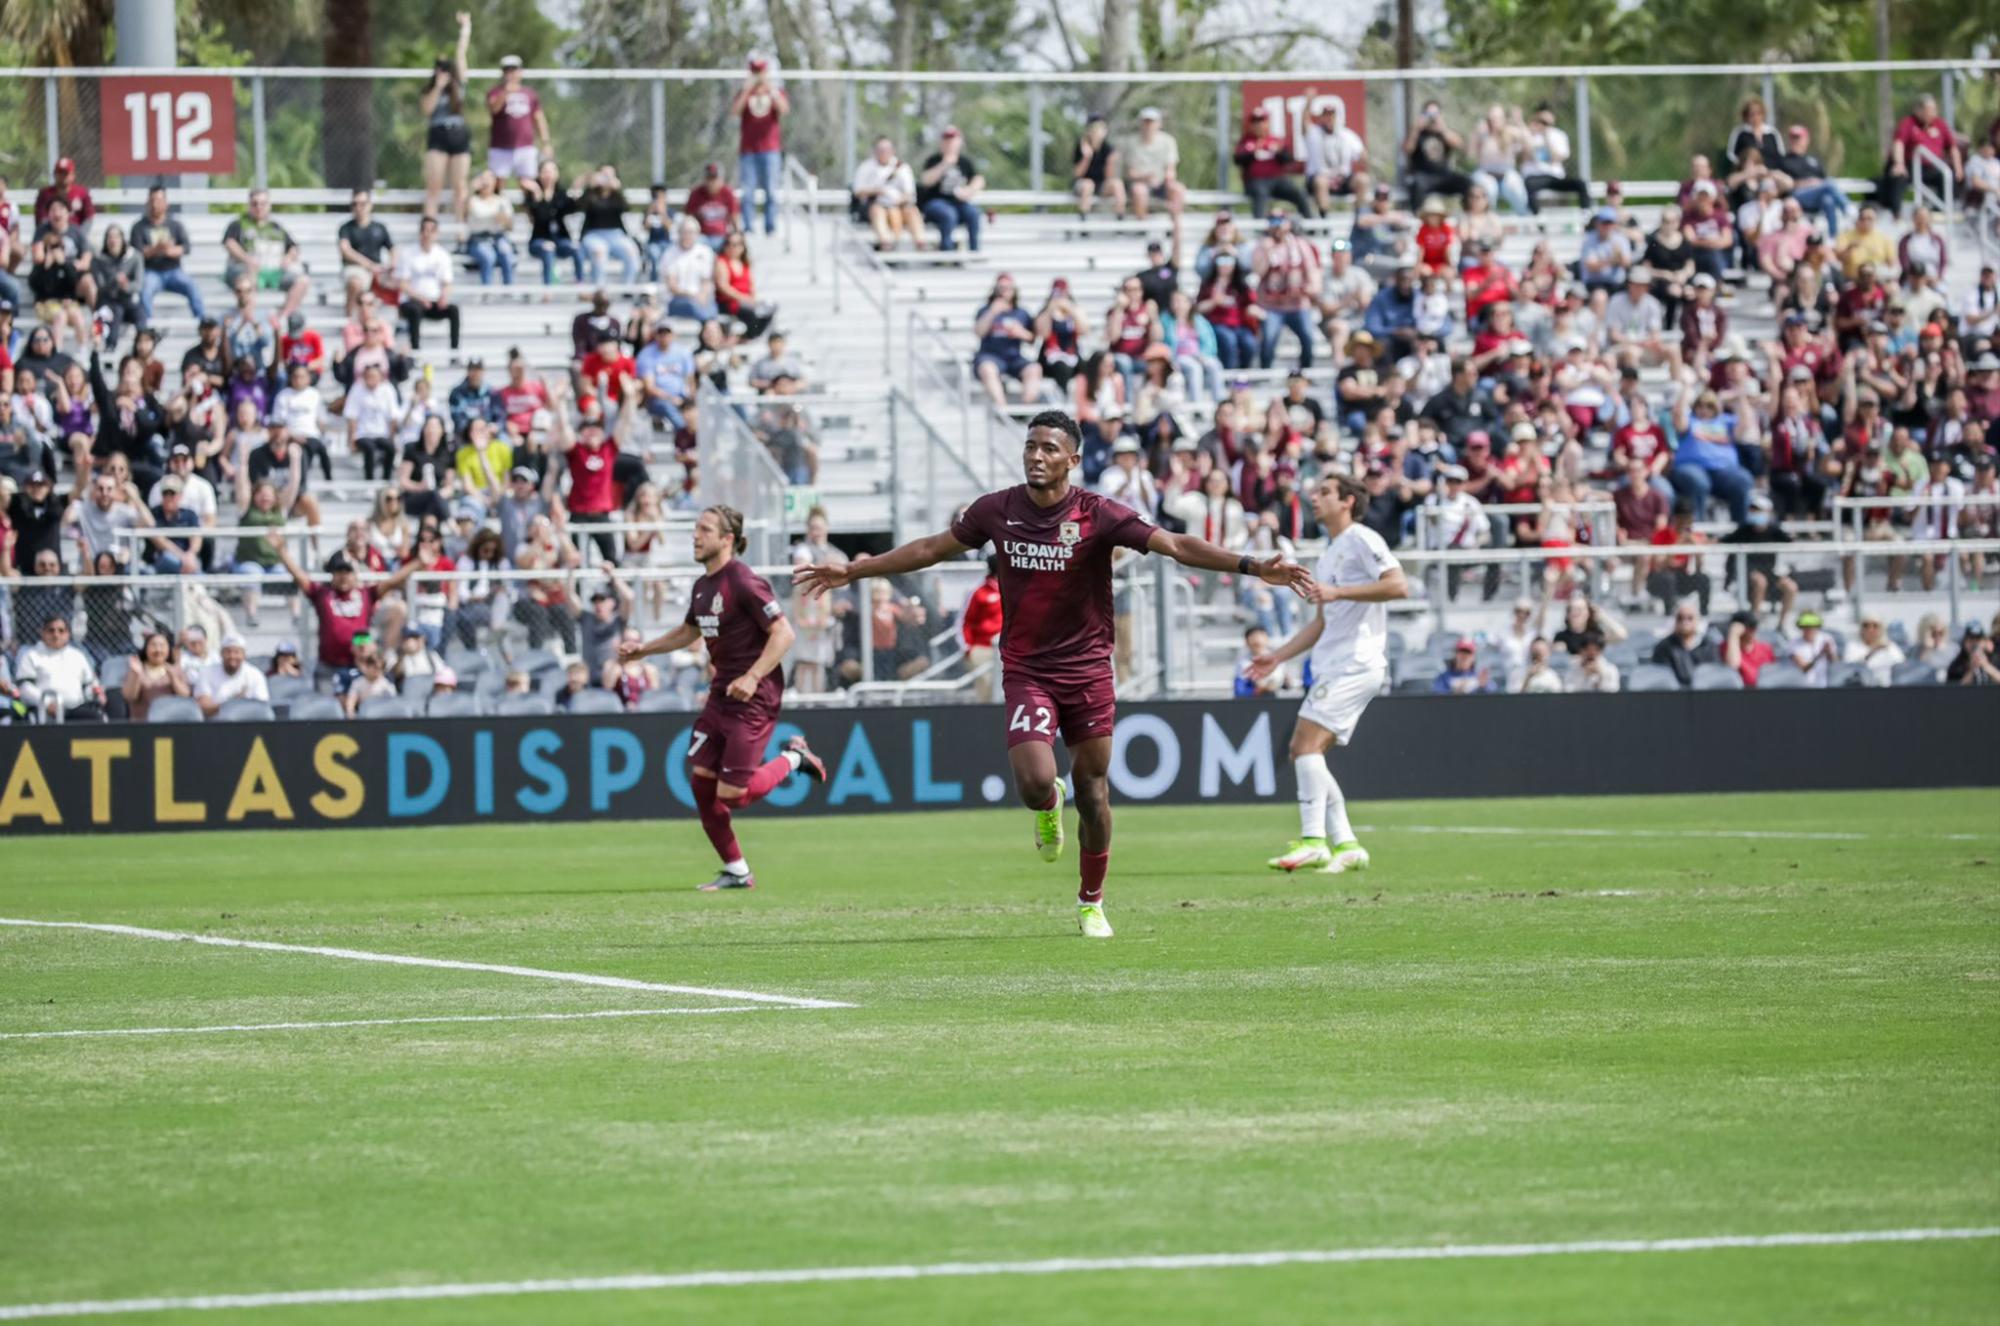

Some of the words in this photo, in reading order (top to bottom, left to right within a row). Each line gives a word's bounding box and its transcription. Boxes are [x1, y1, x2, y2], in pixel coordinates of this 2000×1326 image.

[124, 91, 213, 161] 112
[1010, 556, 1065, 571] HEALTH
[1009, 704, 1051, 736] 42
[687, 730, 708, 757] 7
